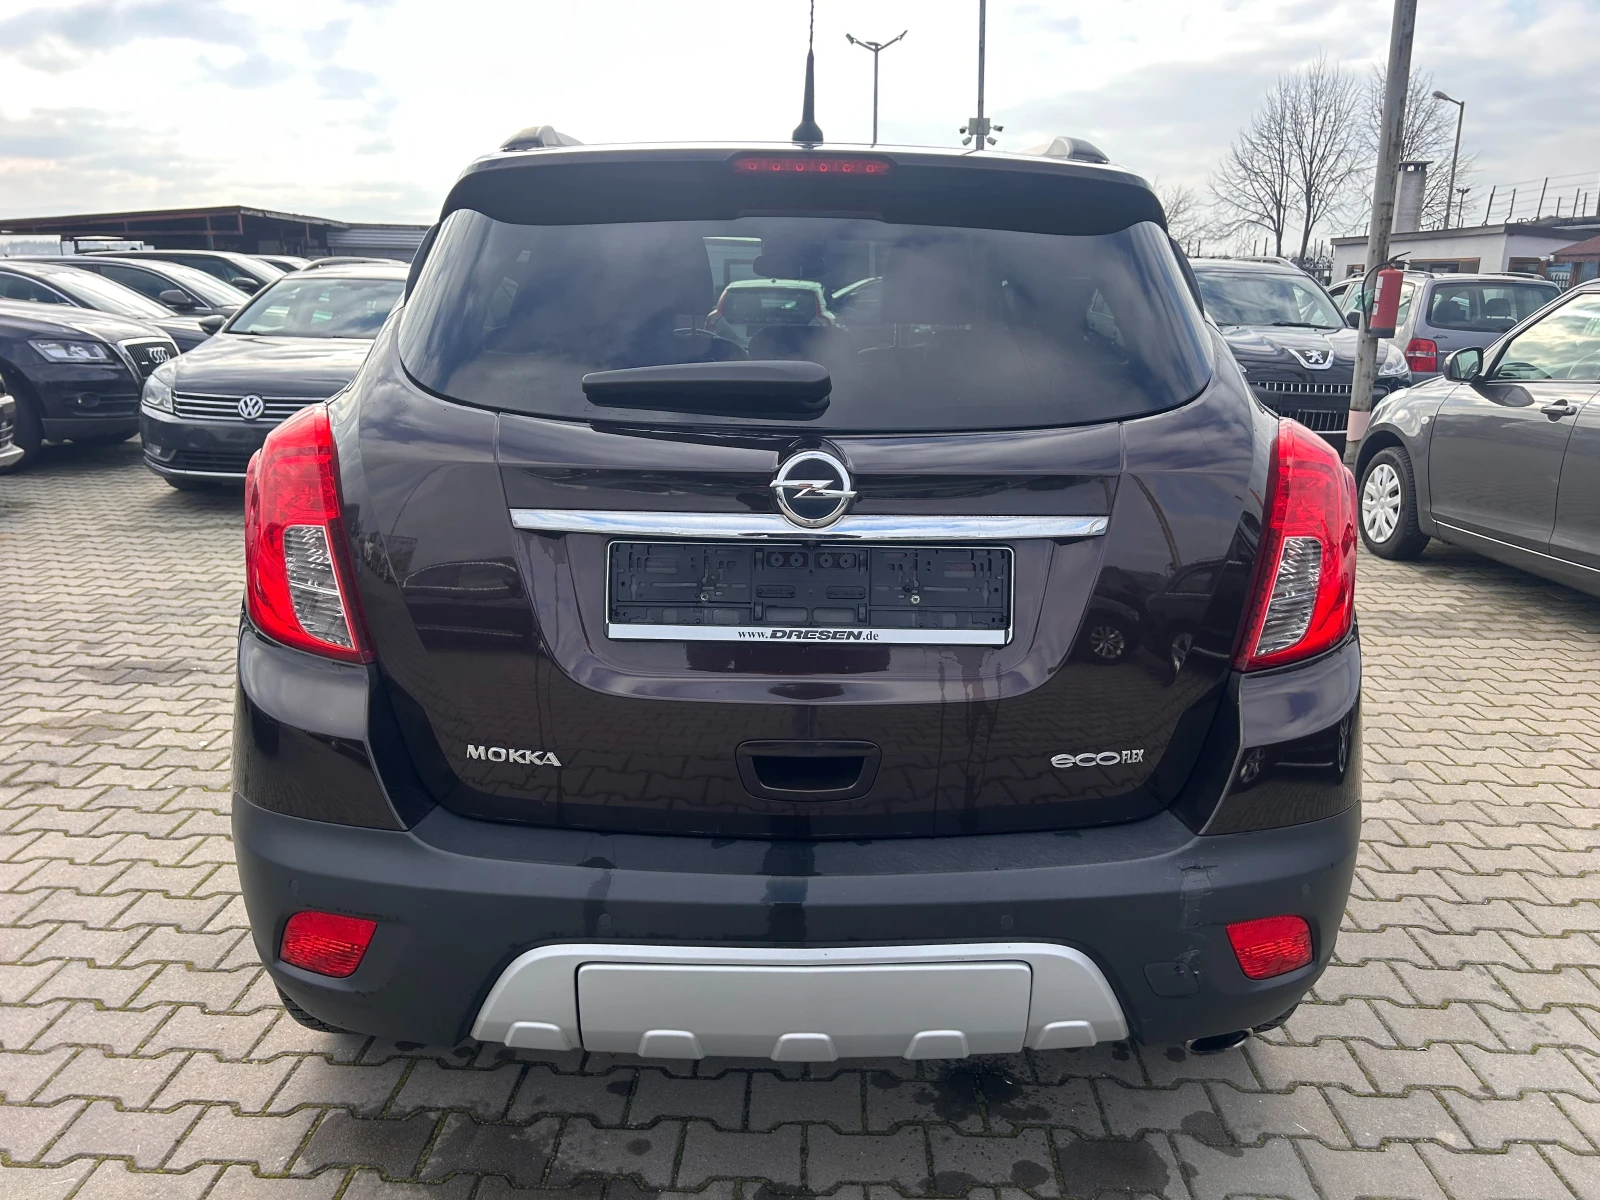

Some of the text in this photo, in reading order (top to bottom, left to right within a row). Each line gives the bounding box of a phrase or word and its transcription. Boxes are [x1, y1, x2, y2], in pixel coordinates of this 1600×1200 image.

[238, 395, 264, 419] VW
[738, 629, 879, 641] www.DRESEN.de
[466, 744, 562, 767] MOKKA
